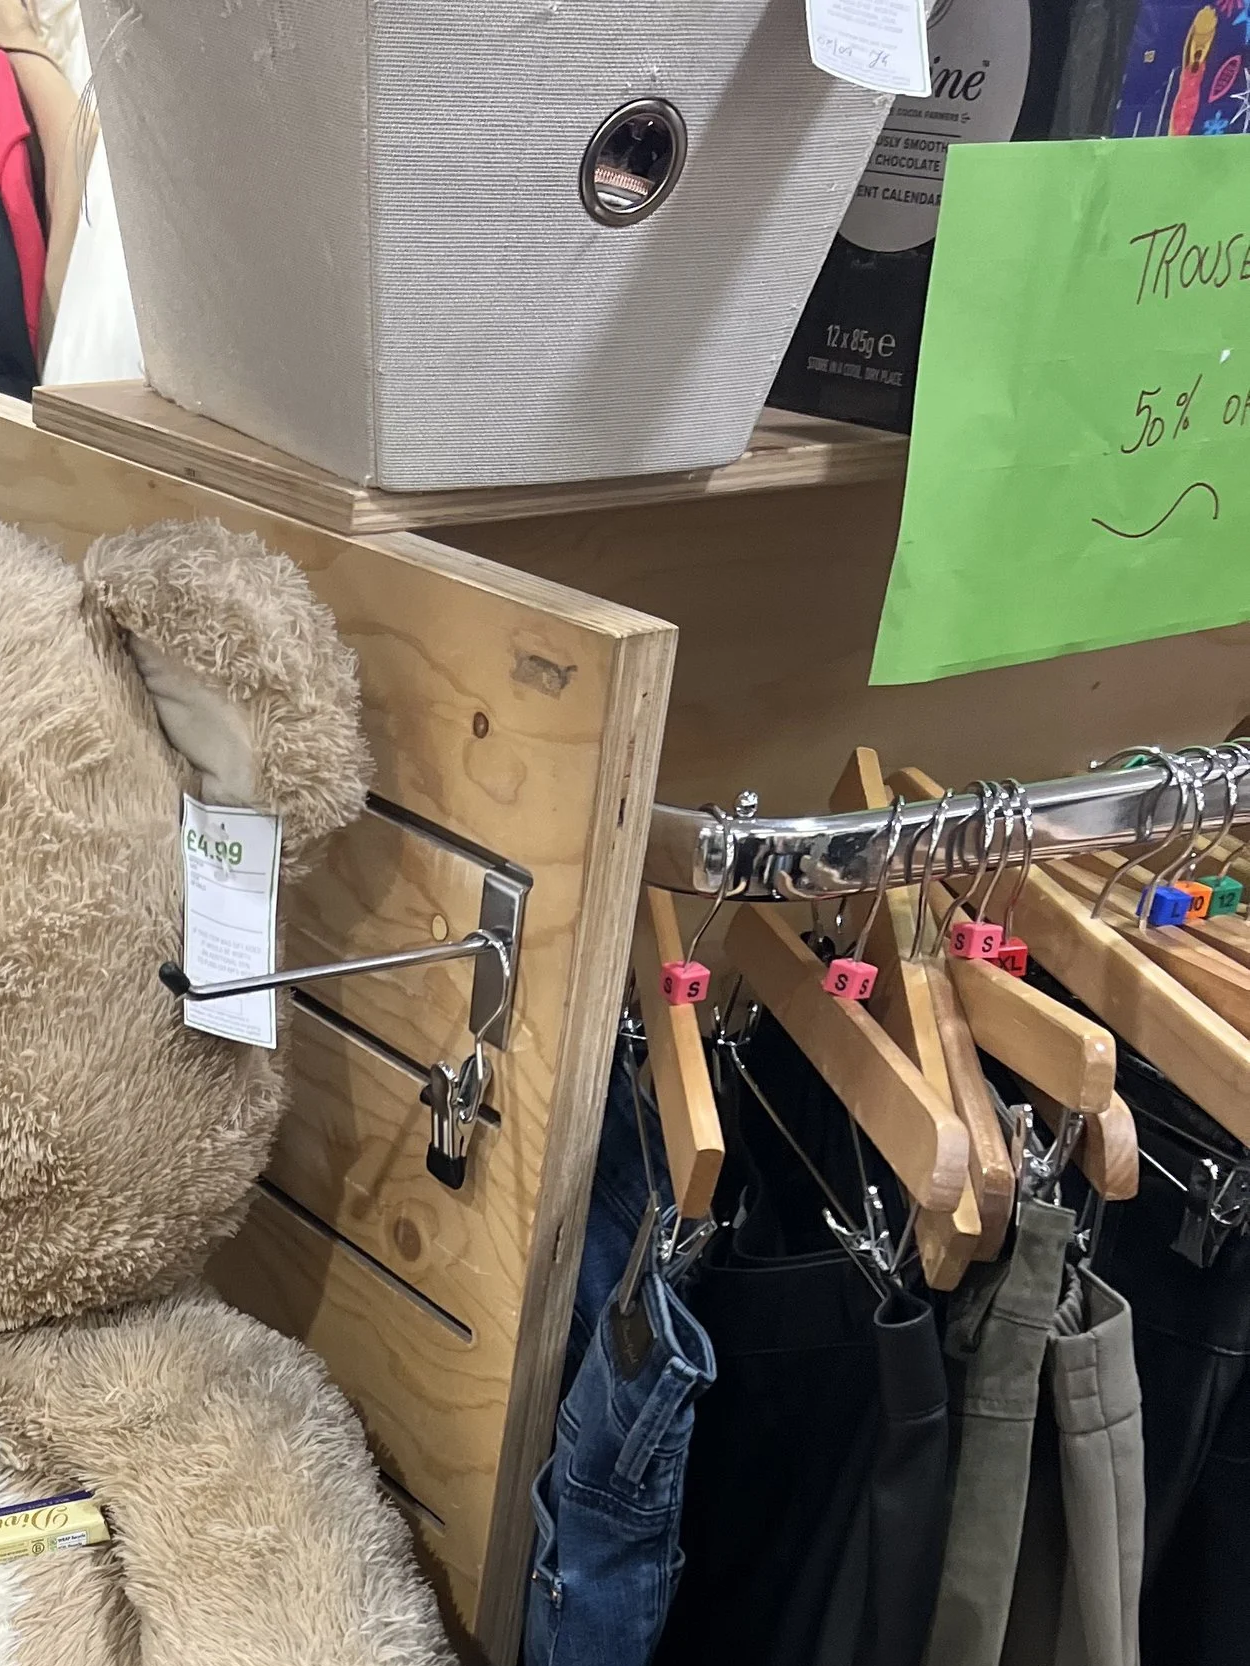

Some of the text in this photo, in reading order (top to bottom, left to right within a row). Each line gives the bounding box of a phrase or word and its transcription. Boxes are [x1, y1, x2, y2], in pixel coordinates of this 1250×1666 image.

[930, 55, 986, 101] ine
[876, 134, 949, 153] USLY SMOOTH
[875, 153, 941, 173] CHOCOLATE
[856, 183, 879, 200] ENT
[850, 328, 875, 359] 85g
[186, 828, 243, 866] £4.99
[1218, 892, 1236, 909] 12
[954, 932, 967, 950] S
[981, 935, 994, 953] S
[663, 976, 673, 994] S
[687, 981, 701, 998] S
[835, 973, 849, 991] S
[858, 978, 870, 995] S
